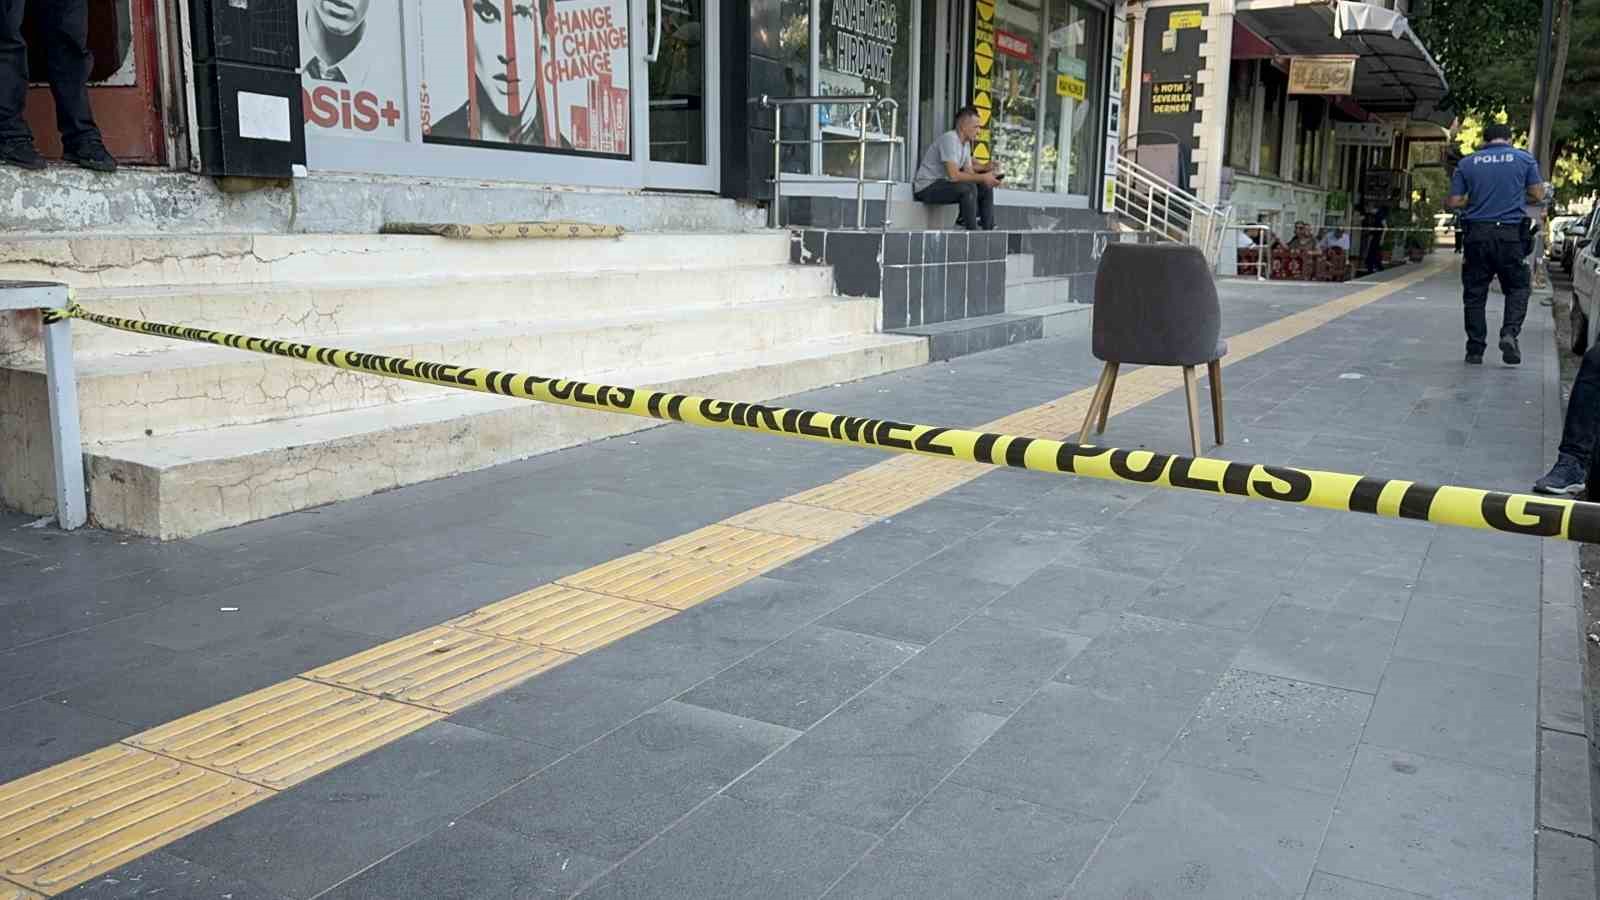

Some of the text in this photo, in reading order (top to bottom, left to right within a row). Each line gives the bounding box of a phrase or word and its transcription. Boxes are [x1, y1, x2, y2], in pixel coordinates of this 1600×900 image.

[562, 27, 627, 57] CHANGE
[836, 31, 893, 84] HIRDAVAT
[544, 52, 613, 84] CHANGE
[1474, 153, 1514, 165] POLIS
